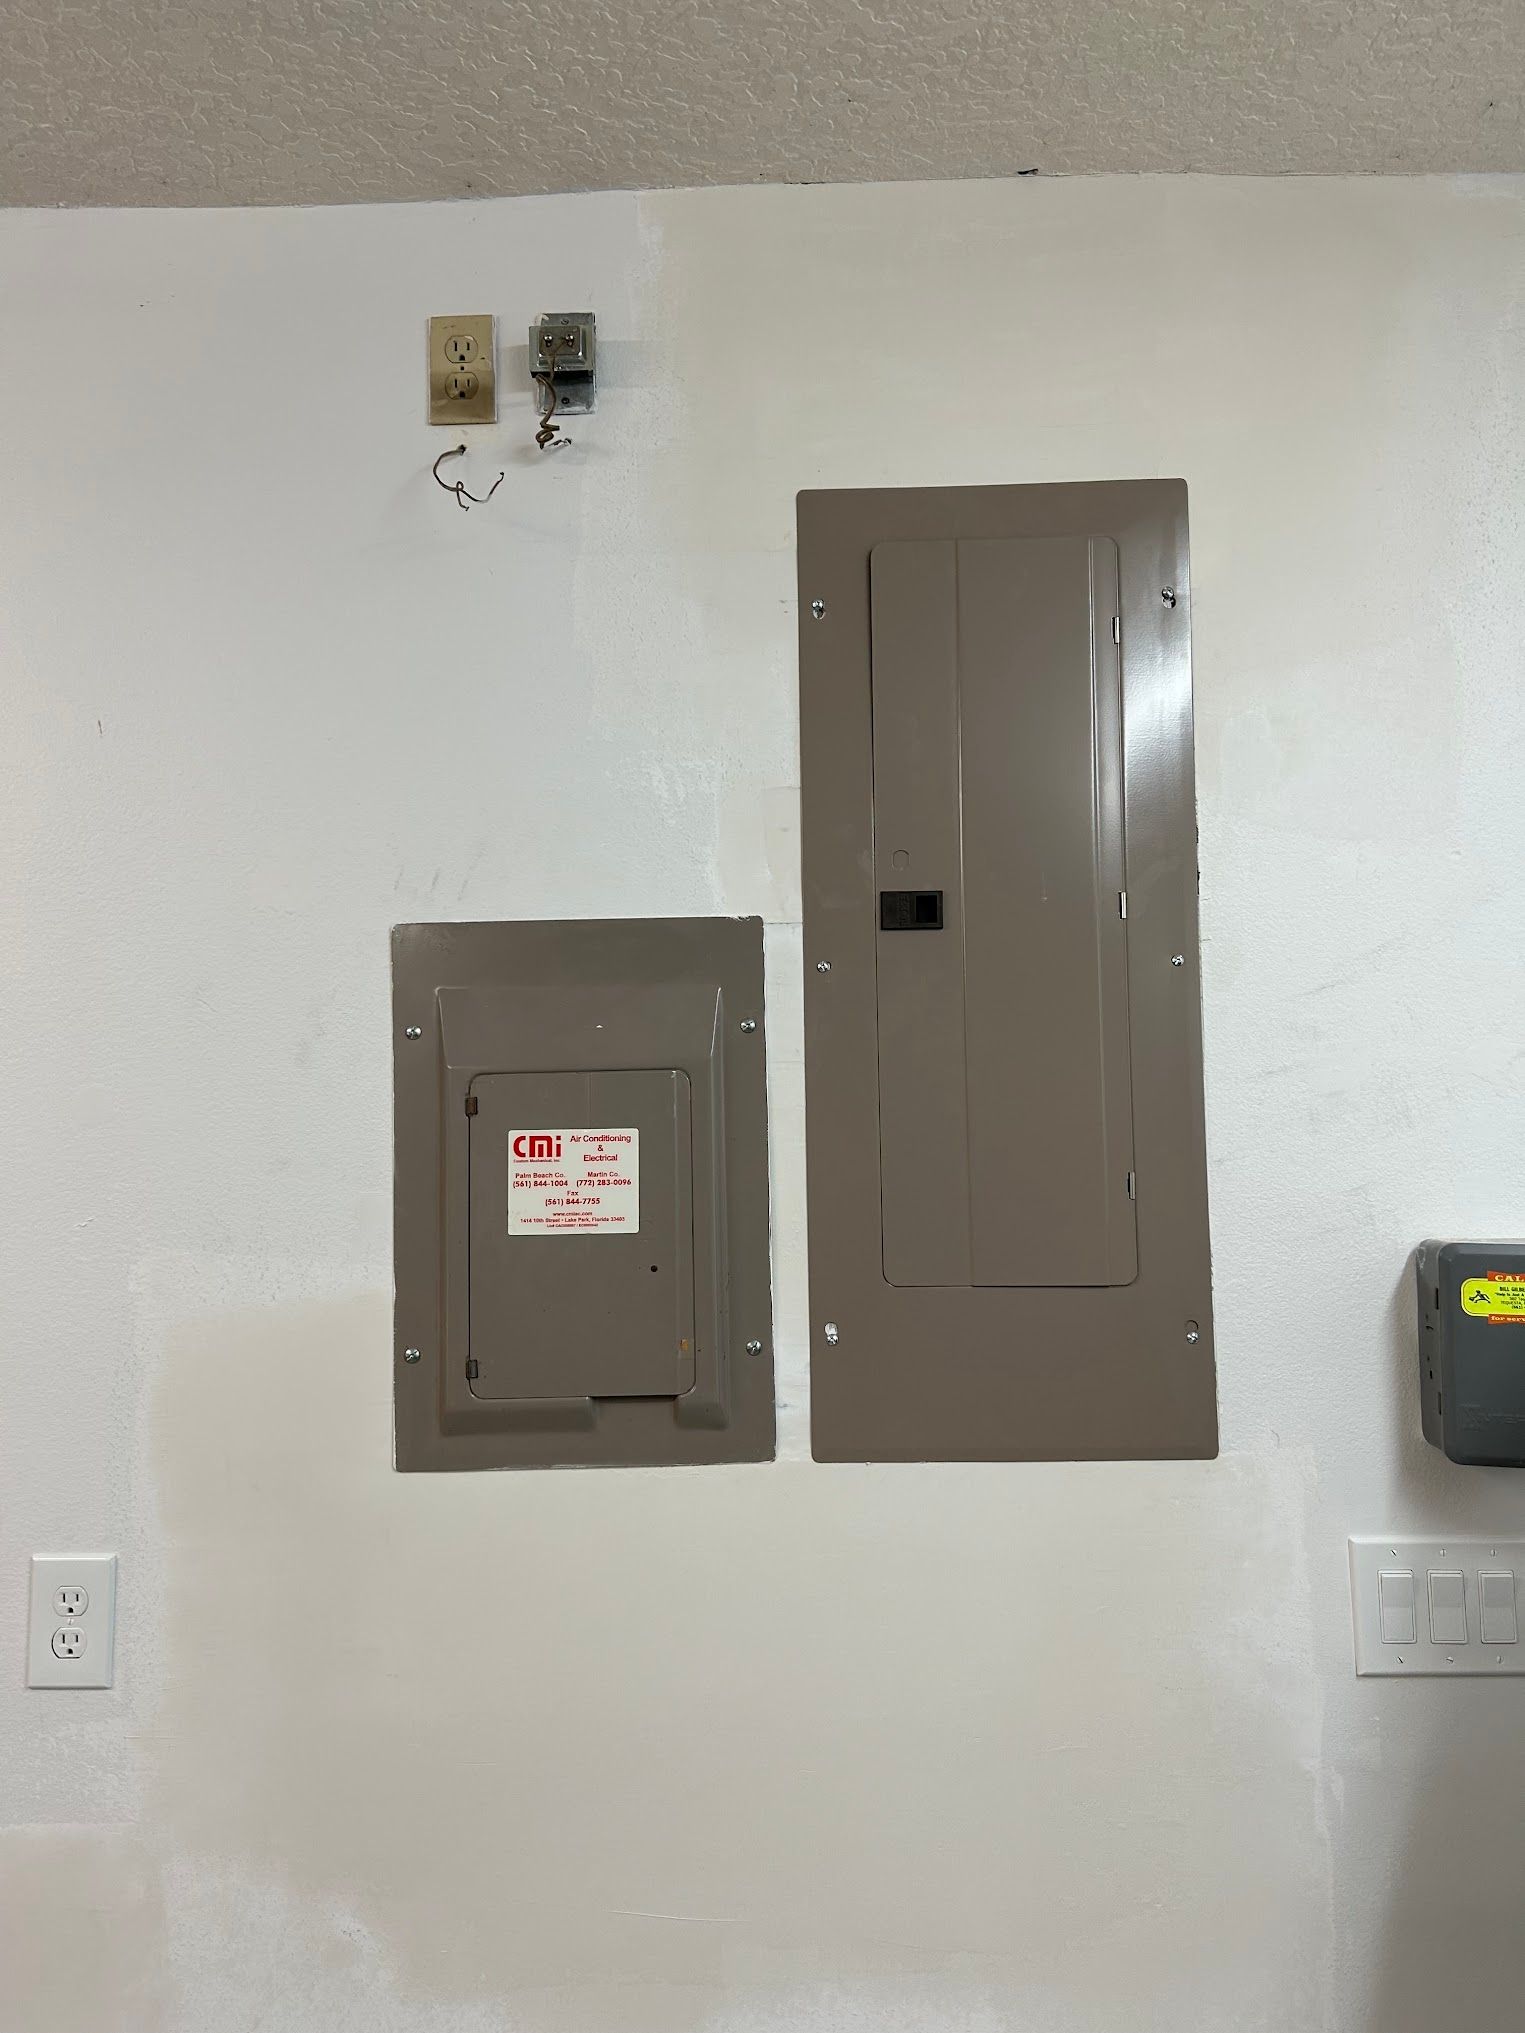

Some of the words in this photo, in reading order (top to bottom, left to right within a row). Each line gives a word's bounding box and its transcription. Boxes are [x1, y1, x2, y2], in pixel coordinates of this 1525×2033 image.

[583, 1134, 631, 1143] Conditioning
[583, 1154, 618, 1162] Electrical
[513, 1180, 531, 1188] (561)
[576, 1179, 595, 1187] (772)
[545, 1198, 563, 1206] (561)
